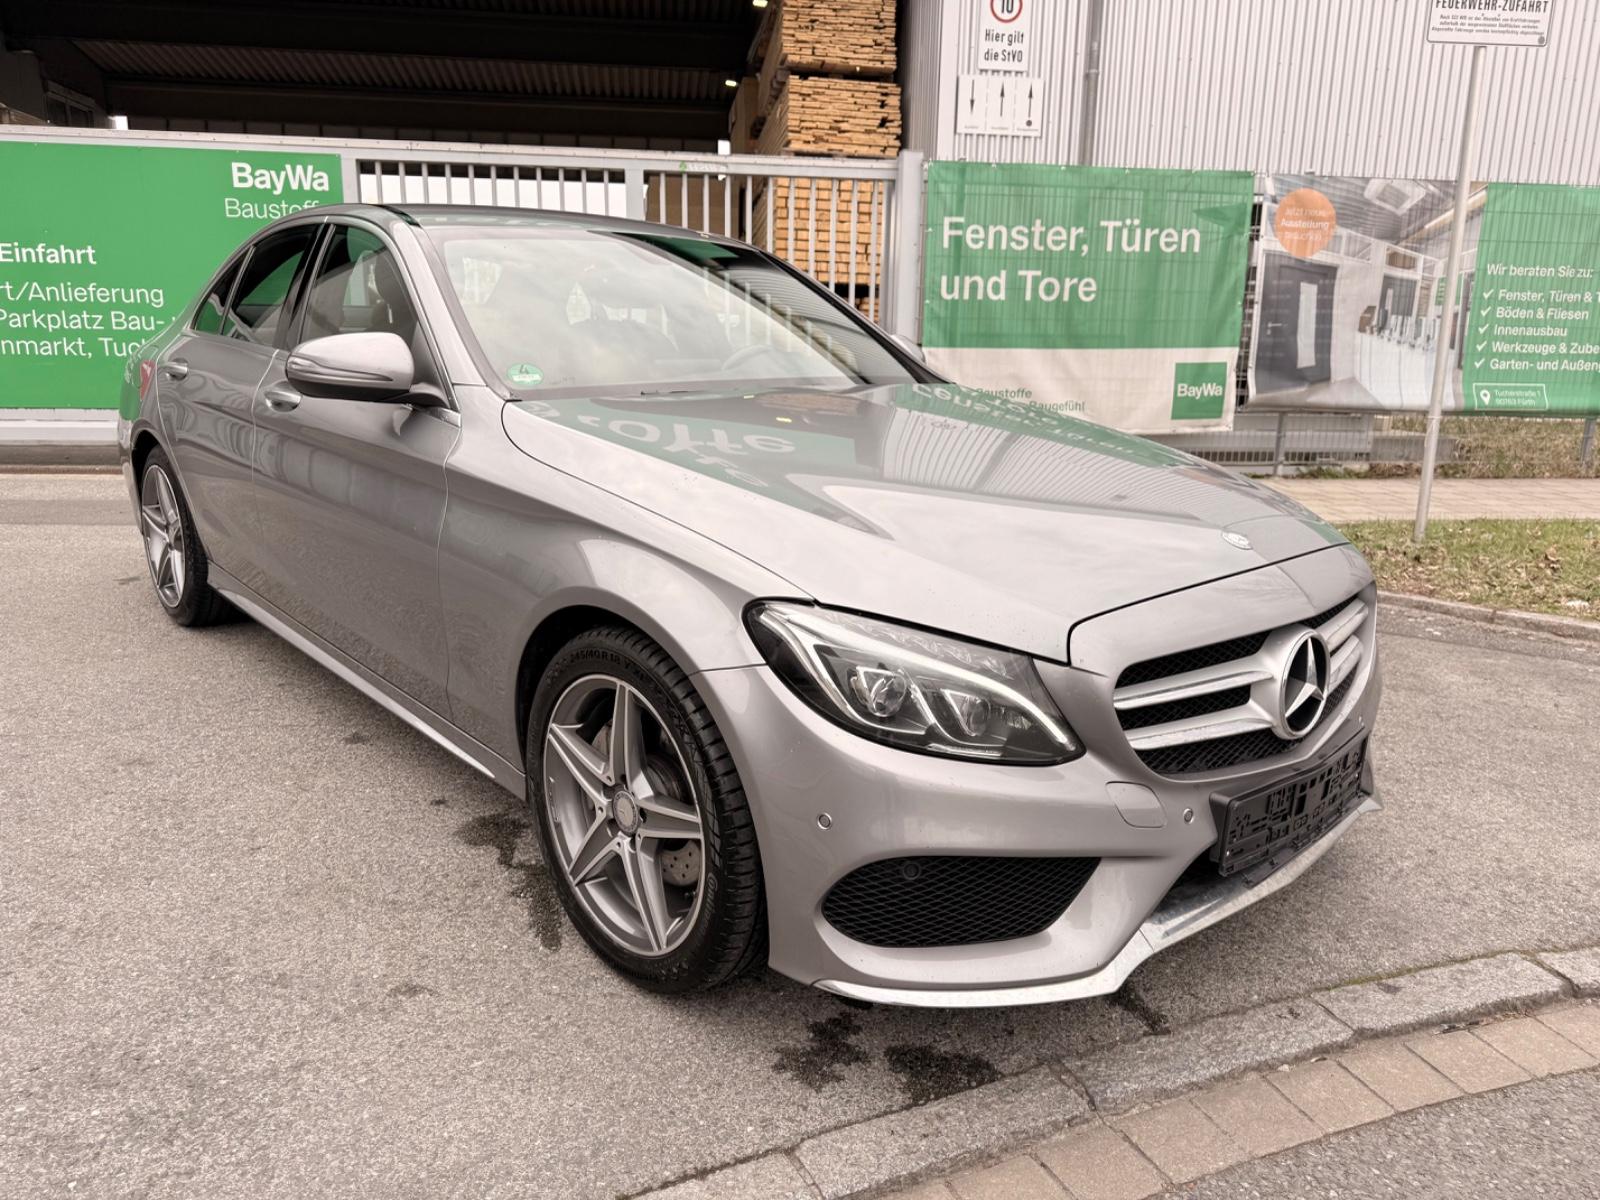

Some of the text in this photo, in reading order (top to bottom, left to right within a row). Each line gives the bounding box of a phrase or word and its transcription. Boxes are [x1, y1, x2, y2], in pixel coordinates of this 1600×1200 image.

[1435, 0, 1549, 13] FEUERWEHR-ZUFAHRT
[984, 28, 1024, 47] Hier gilt
[984, 47, 1023, 63] die StVO
[231, 161, 329, 195] BayWa
[942, 216, 1201, 256] Fenster, Türen
[0, 242, 97, 265] Einfahrt
[1487, 263, 1594, 279] Wir beraten Sie zu:
[940, 270, 1098, 303] und Tore
[1498, 289, 1545, 303] Fenster,
[1549, 289, 1582, 302] Türen
[1583, 291, 1593, 303] &
[110, 310, 166, 331] Bau-
[1496, 306, 1590, 320] Böden & Fliesen
[1494, 323, 1568, 337] Innenausbau
[97, 337, 146, 357] Tuc
[1491, 341, 1557, 355] Werkzeuge
[1559, 342, 1568, 354] &
[1489, 358, 1535, 371] Garten-
[1536, 359, 1559, 371] und
[1176, 382, 1224, 400] BayWa
